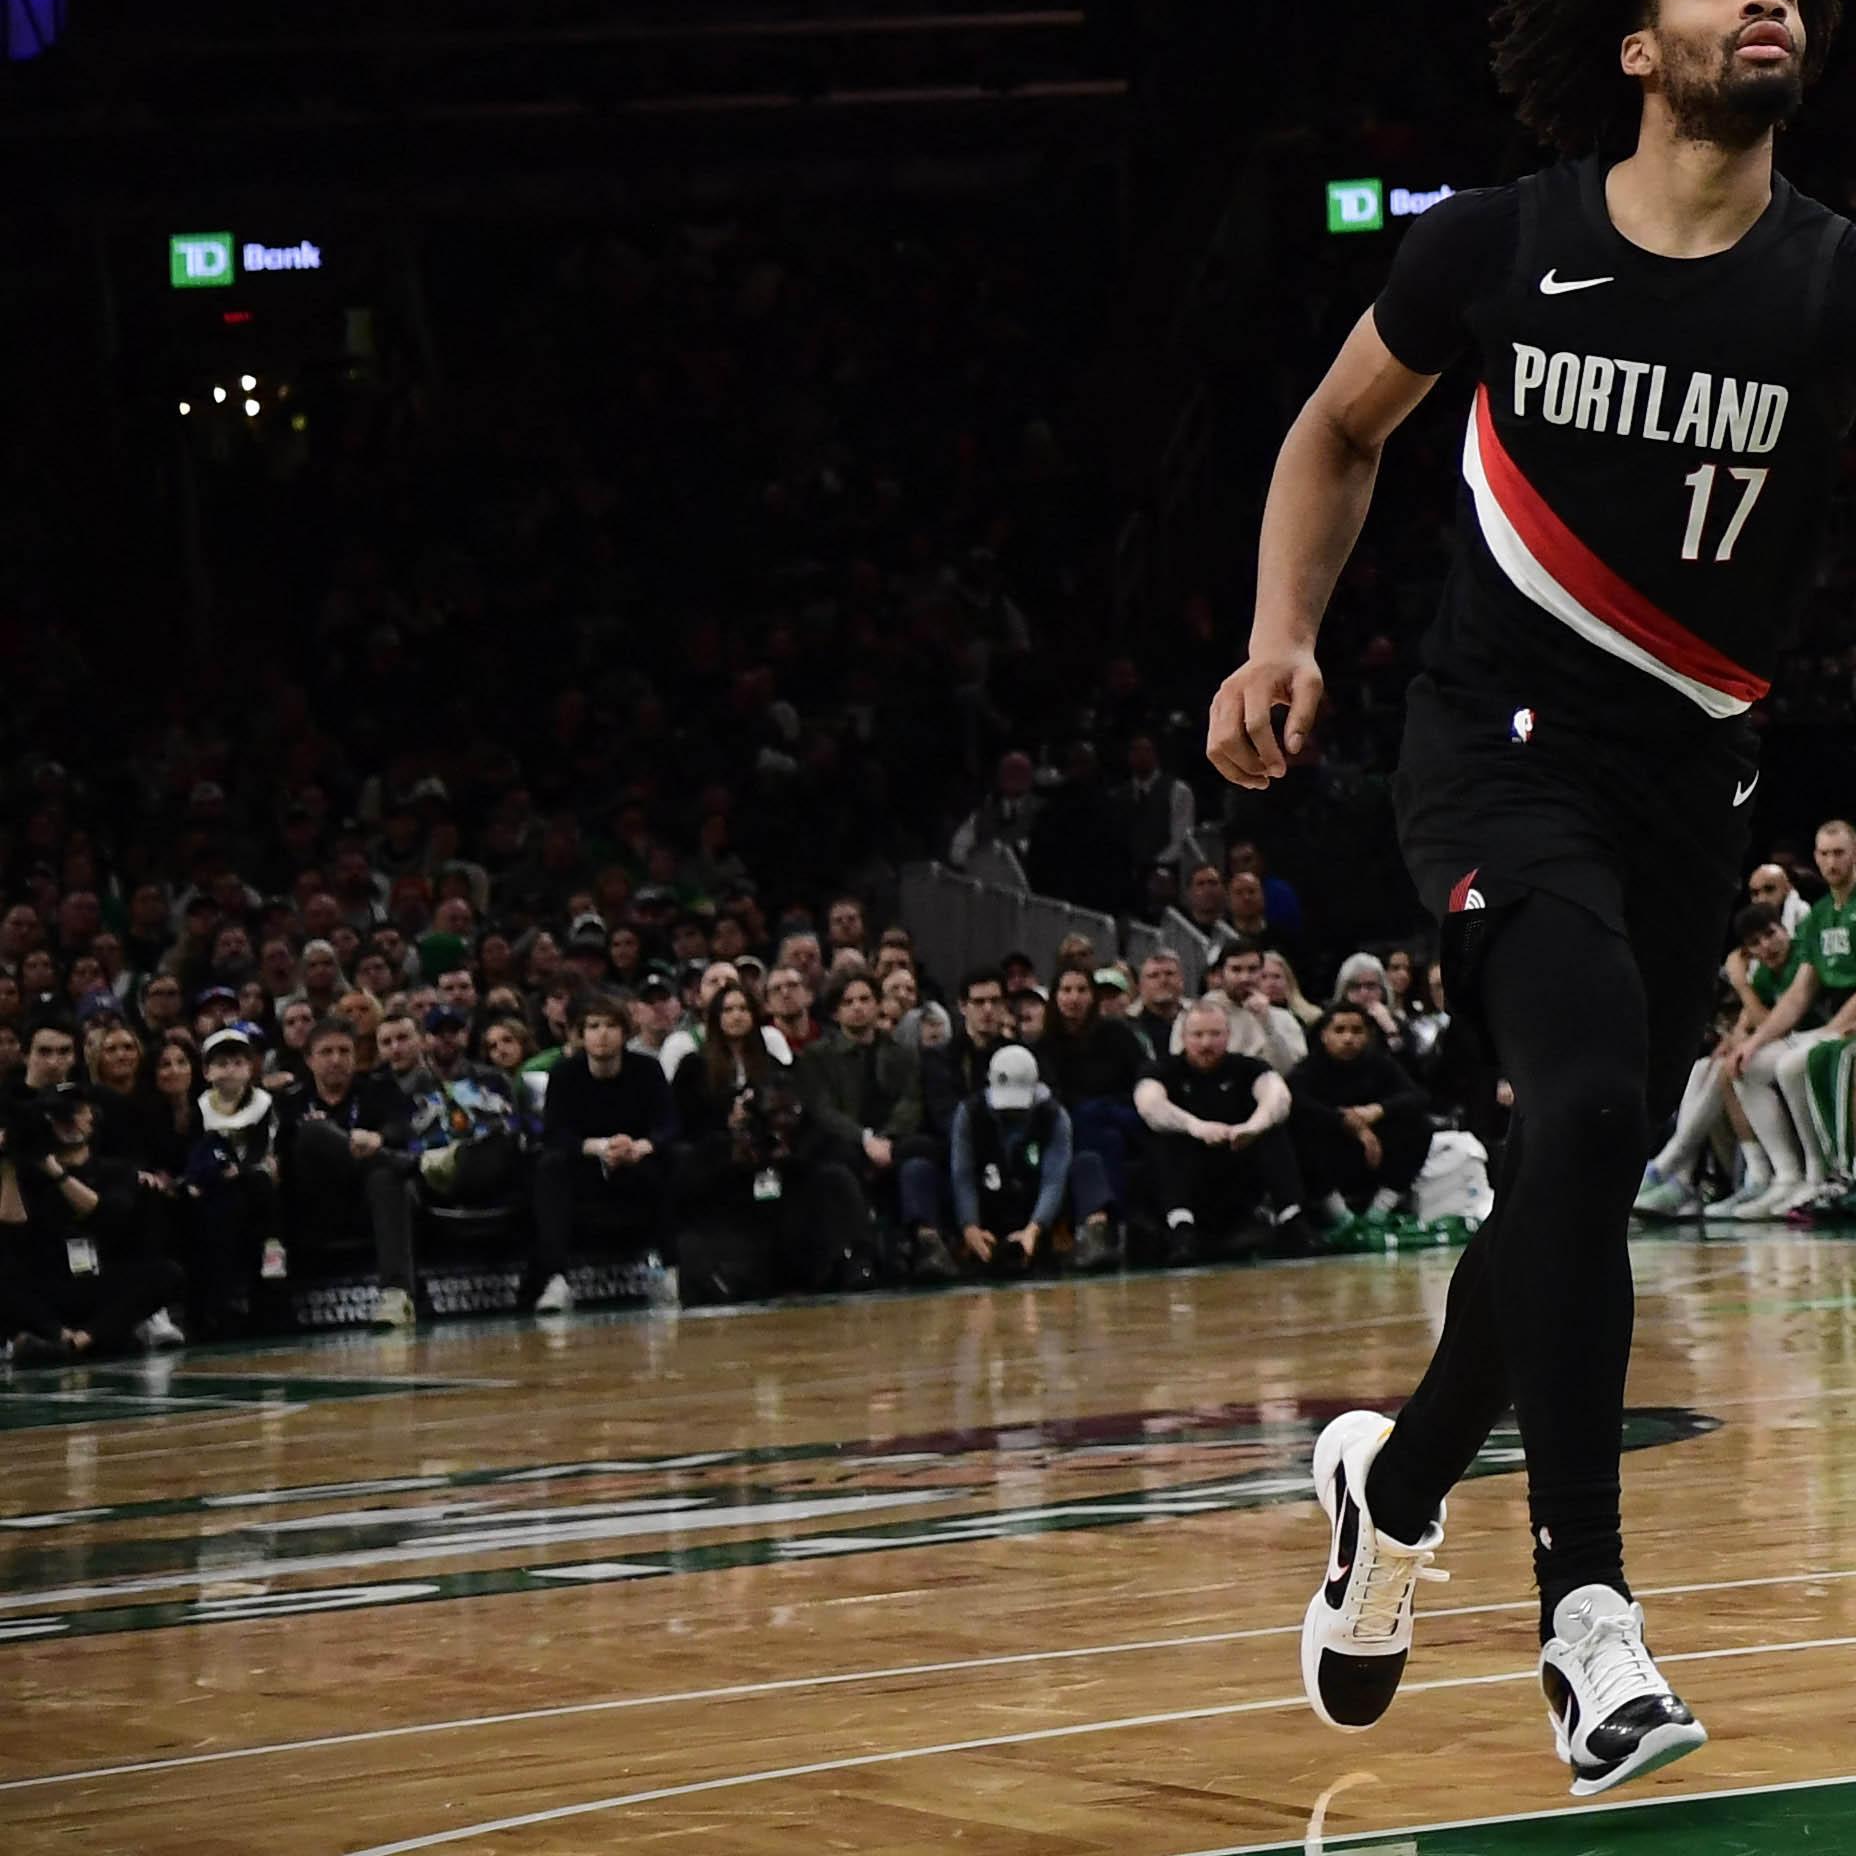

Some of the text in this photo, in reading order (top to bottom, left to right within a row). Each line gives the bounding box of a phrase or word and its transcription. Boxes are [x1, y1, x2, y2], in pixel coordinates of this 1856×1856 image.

[1334, 187, 1378, 222] TD
[175, 240, 321, 278] TD Bank
[1512, 342, 1790, 454] PORTLAND
[1680, 462, 1771, 563] 17
